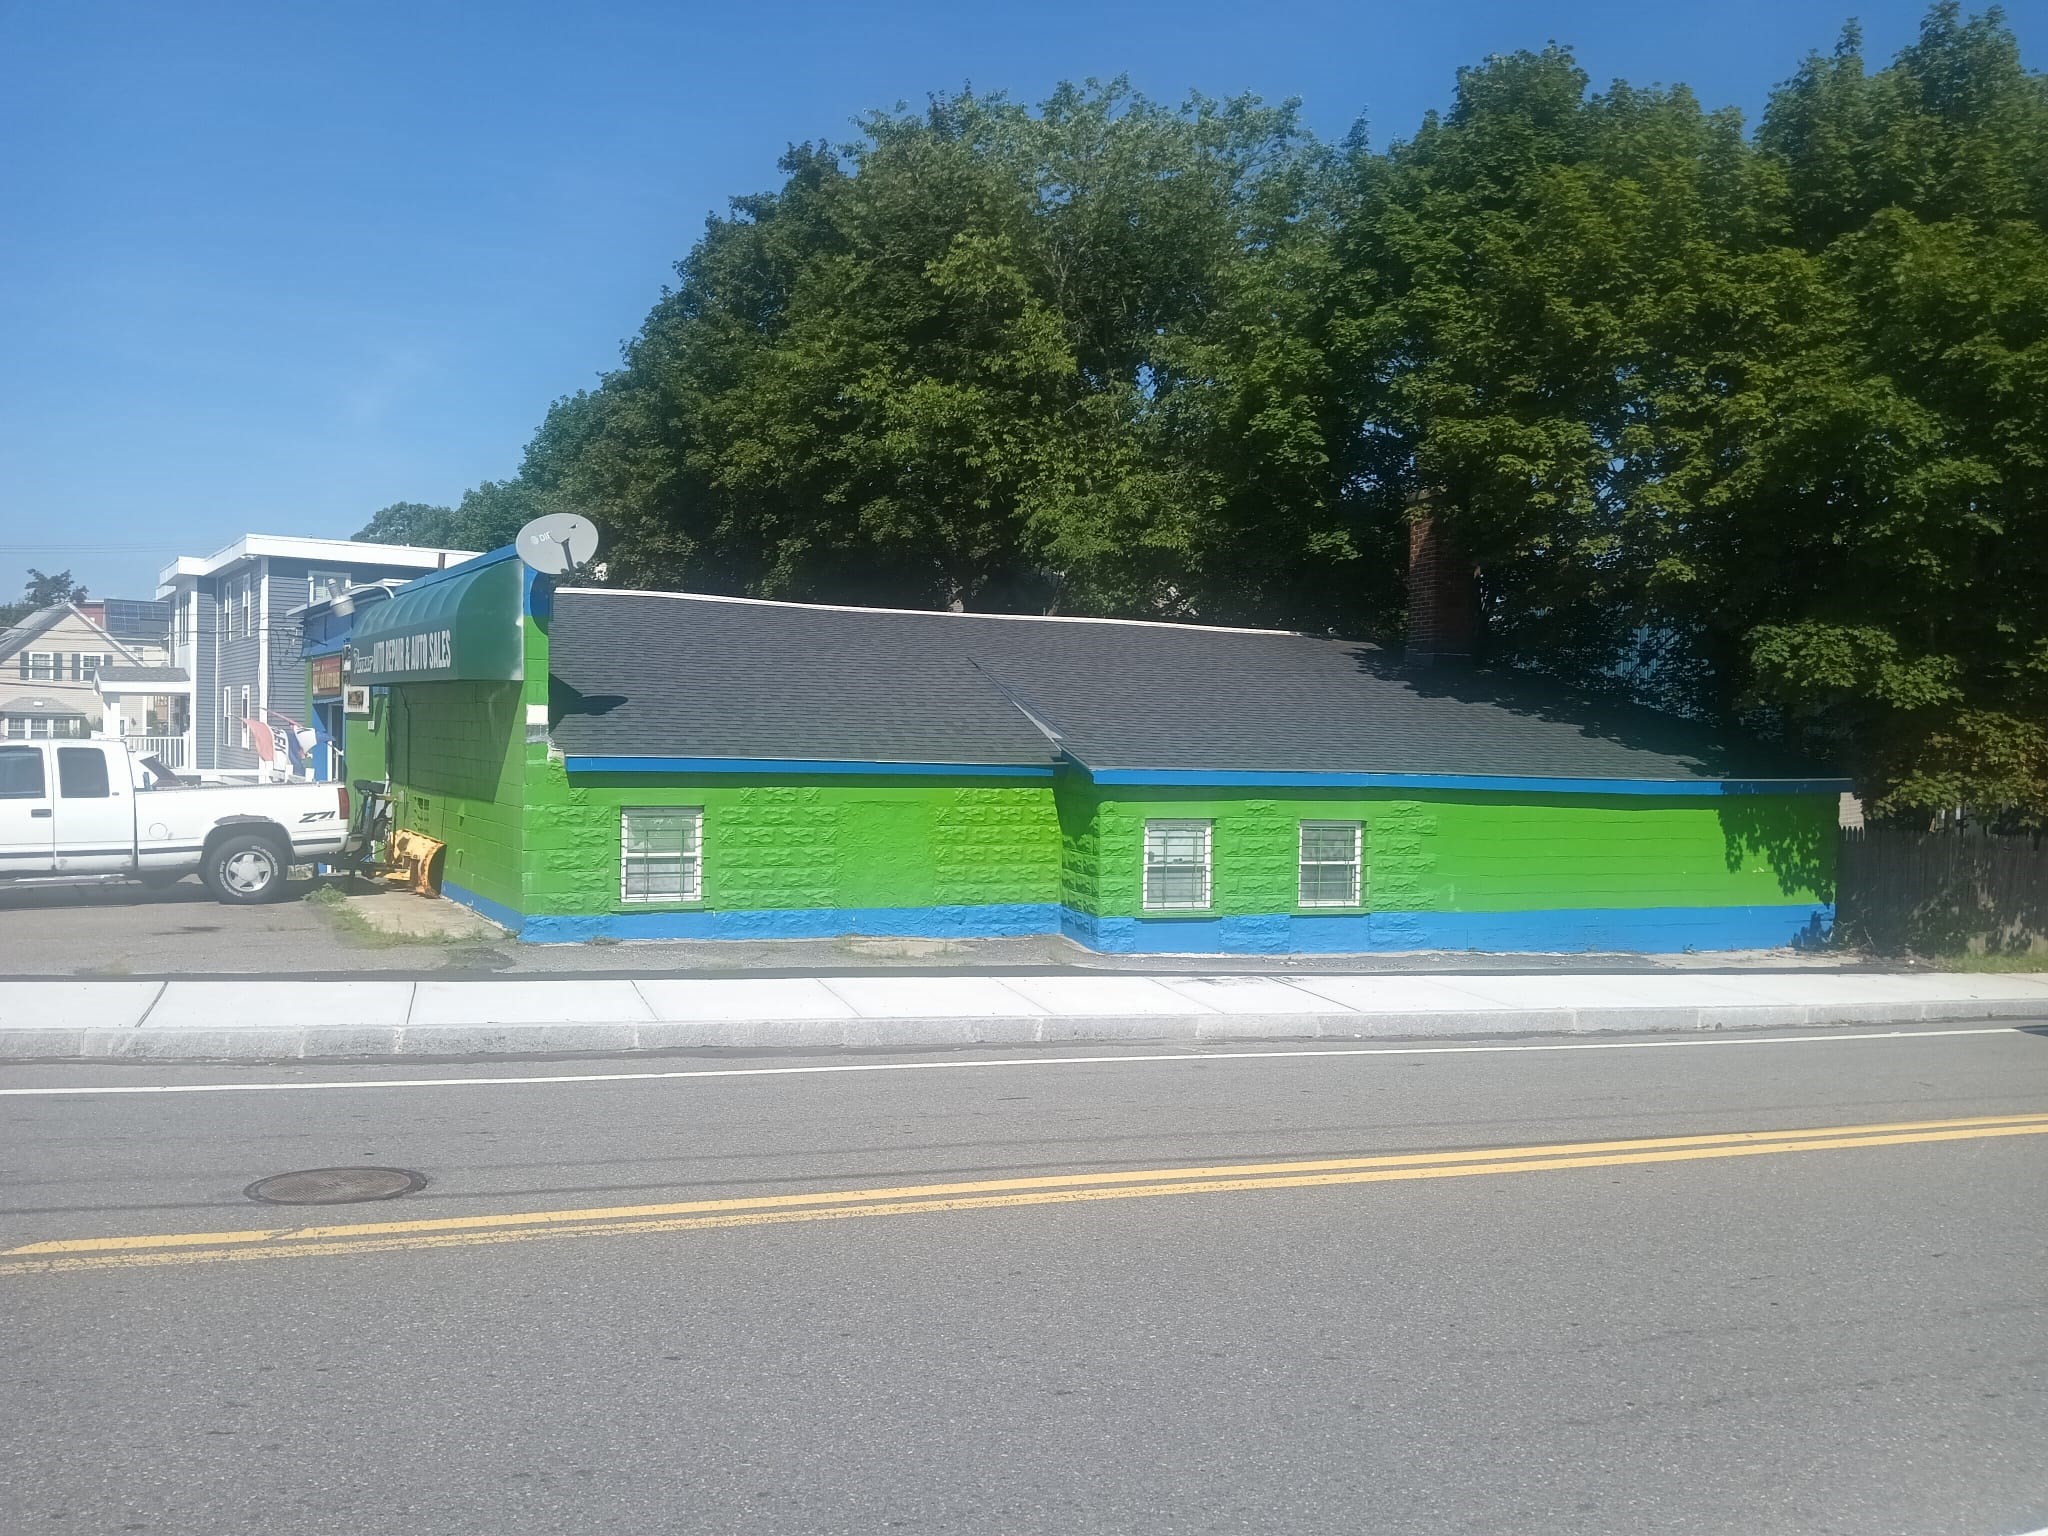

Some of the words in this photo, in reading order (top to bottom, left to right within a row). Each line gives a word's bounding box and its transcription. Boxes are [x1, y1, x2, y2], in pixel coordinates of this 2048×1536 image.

[373, 641, 385, 673] AUTO
[385, 638, 404, 672] REPAIR
[405, 636, 410, 671] &
[411, 634, 428, 670] AUTO
[429, 629, 451, 669] SALES
[298, 811, 335, 823] Z71
